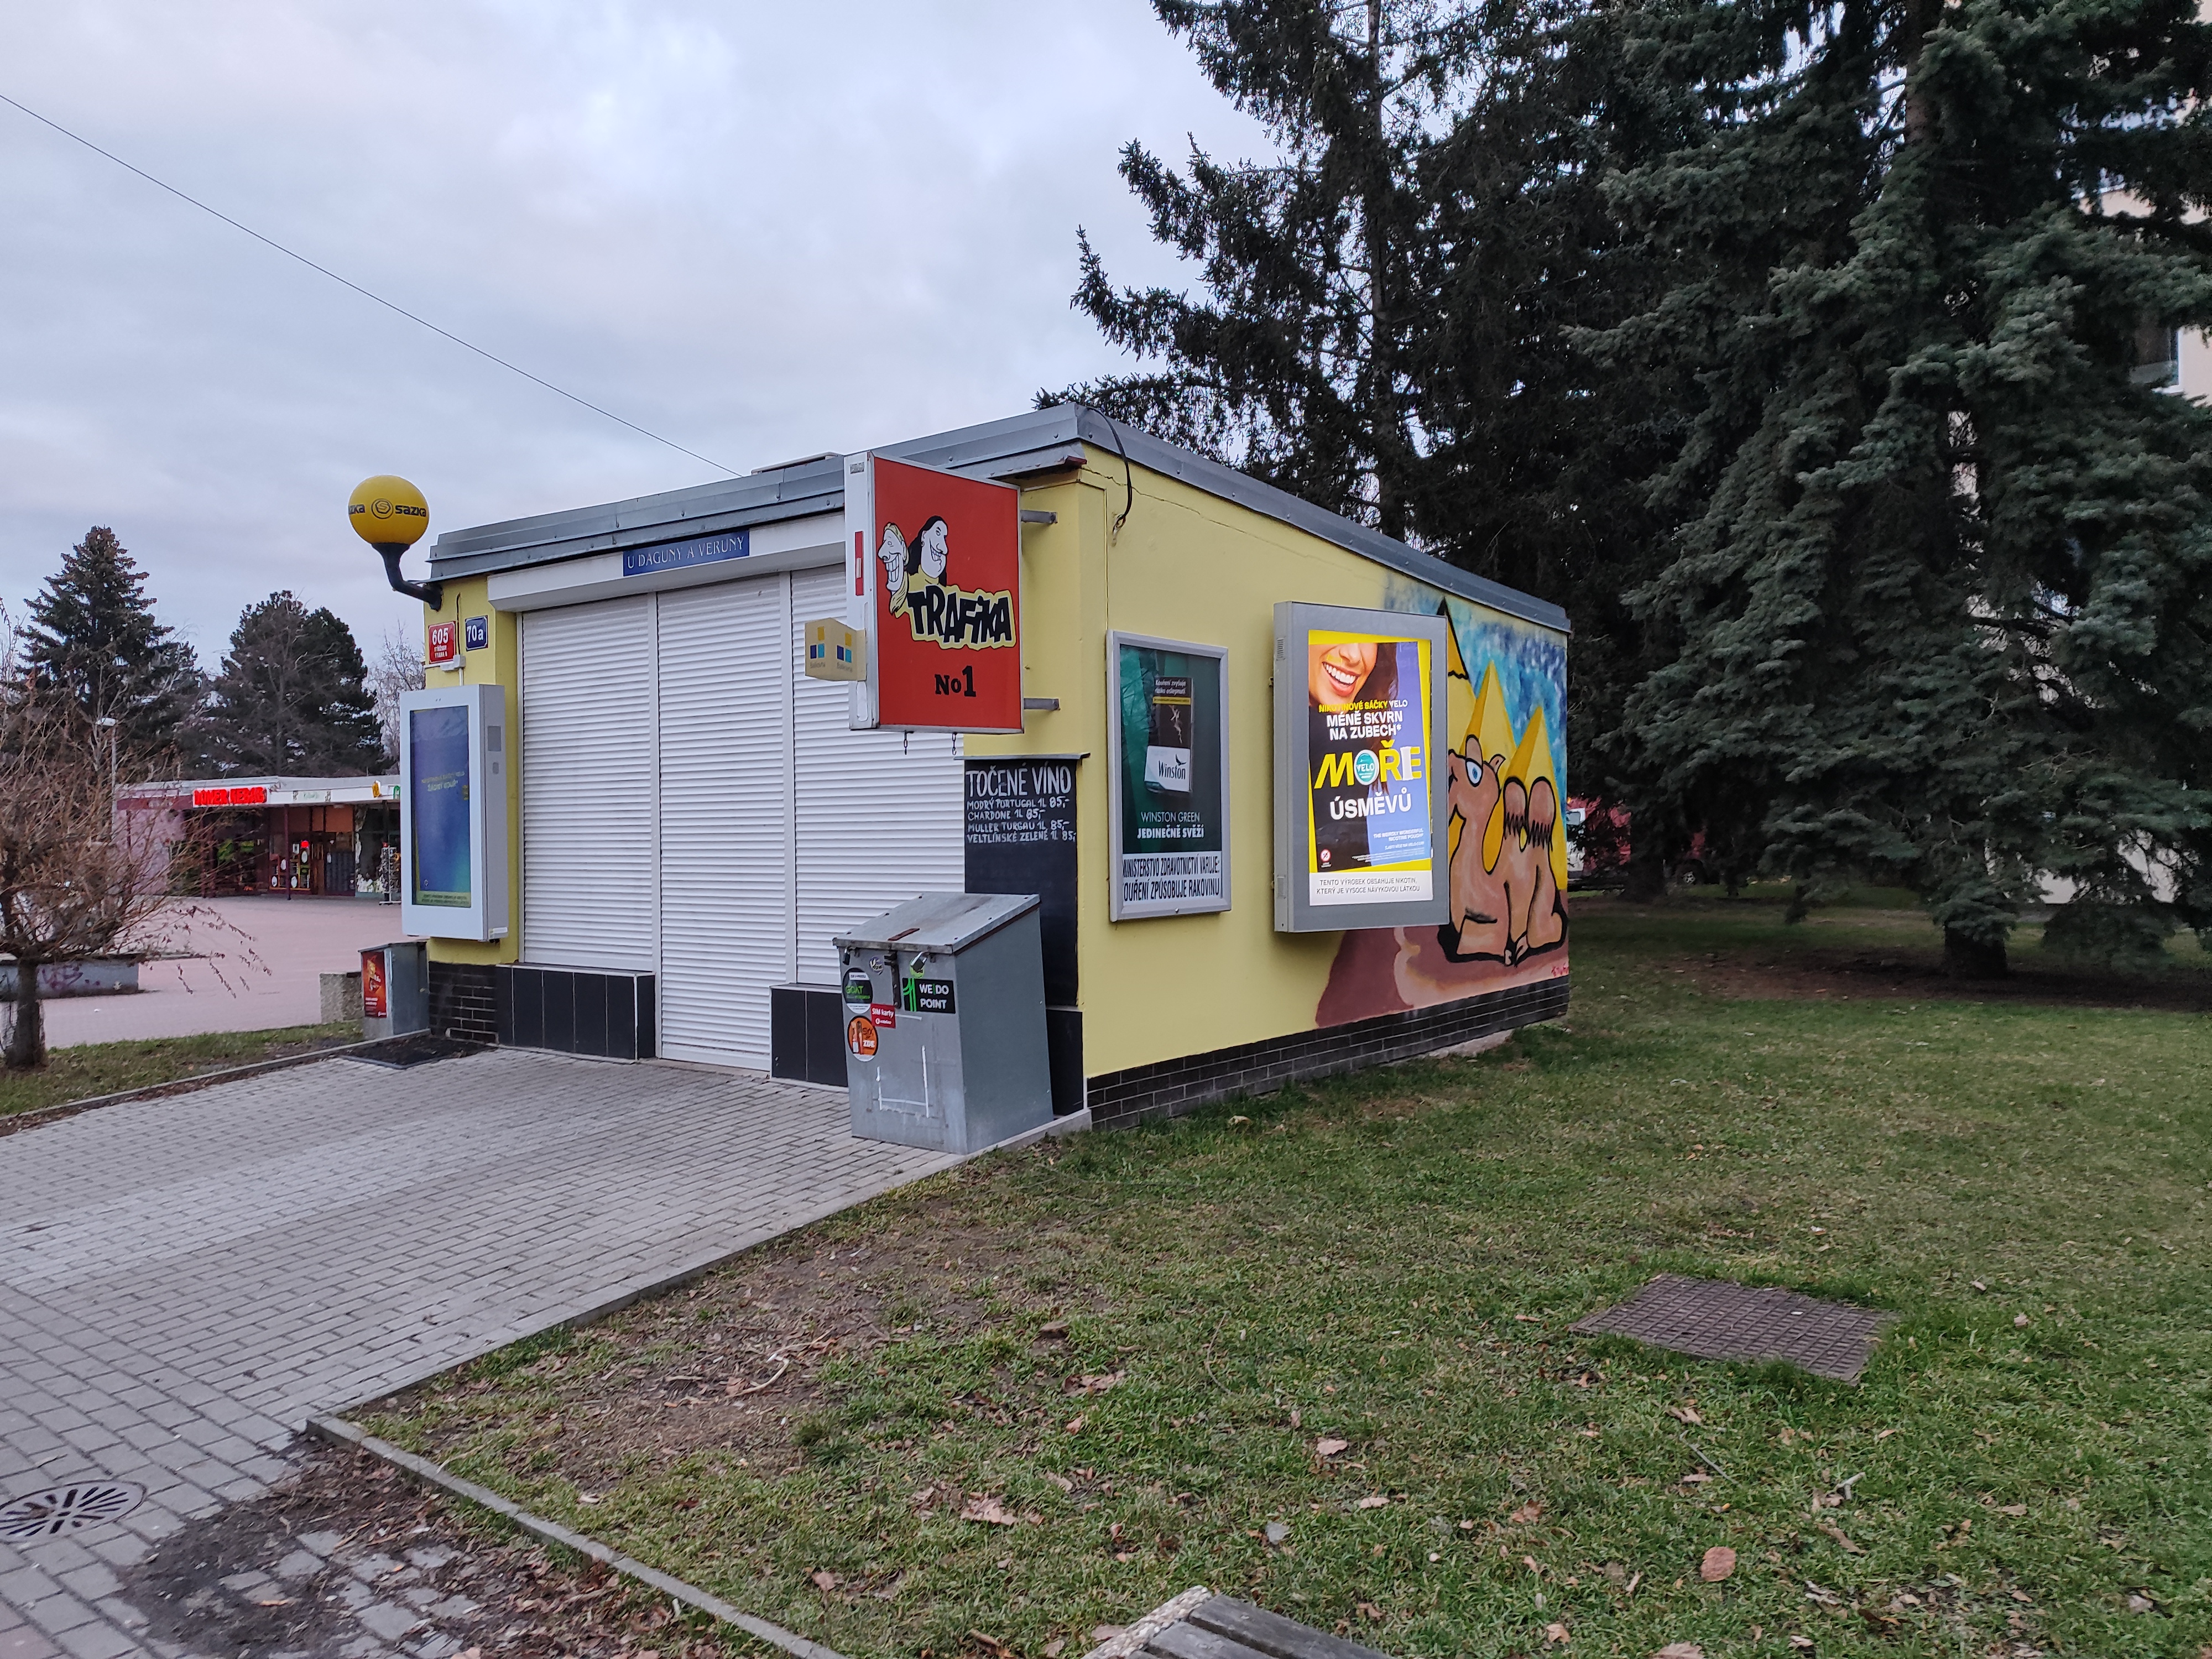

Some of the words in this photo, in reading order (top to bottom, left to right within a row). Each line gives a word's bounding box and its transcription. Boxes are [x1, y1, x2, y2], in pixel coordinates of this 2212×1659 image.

[628, 555, 634, 568] U
[638, 546, 682, 567] DAGUNY
[687, 546, 695, 559] A
[698, 536, 744, 557] VERUNY
[432, 627, 448, 645] 605
[466, 624, 484, 643] 70a
[1318, 700, 1364, 713] NIKOTINOVÉ
[1364, 699, 1388, 710] SÁČKY
[1389, 699, 1408, 708] VELO
[1326, 710, 1362, 727] MÉNĚ
[1364, 710, 1403, 724] SKVRN
[1329, 727, 1348, 740] NA
[1158, 759, 1186, 780] Winston
[1356, 763, 1375, 773] VELO
[966, 762, 1028, 797] TOČENÉ
[1031, 761, 1072, 795] VÍNO
[967, 796, 994, 811] MODRÝ
[996, 798, 1036, 809] PORTUGAL
[1037, 797, 1047, 808] 1L
[1329, 787, 1412, 821] ÚSMĚVŮ
[968, 810, 1011, 821] CHARDONE
[1014, 808, 1023, 818] 1L
[1140, 811, 1176, 823] WINSTON
[1177, 811, 1201, 823] GREEN
[967, 822, 999, 833] MULLER
[1001, 821, 1035, 831] TURGAU
[1036, 820, 1046, 830] 1L
[1136, 824, 1181, 839] JEDINEČNĚ
[1182, 823, 1204, 838] SVĚŽÍ
[967, 830, 1018, 844] VELTLÍNSKÉ
[1019, 828, 1049, 842] ZELENÉ
[1050, 830, 1058, 841] 1L
[1160, 853, 1199, 876] ZDRAVOTNICTVÍ
[1123, 878, 1150, 901] OUŘENÍ
[1188, 878, 1220, 898] RAKOVINU
[845, 985, 864, 994] GOAT
[920, 998, 947, 1010] POINT
[881, 1008, 894, 1019] karty
